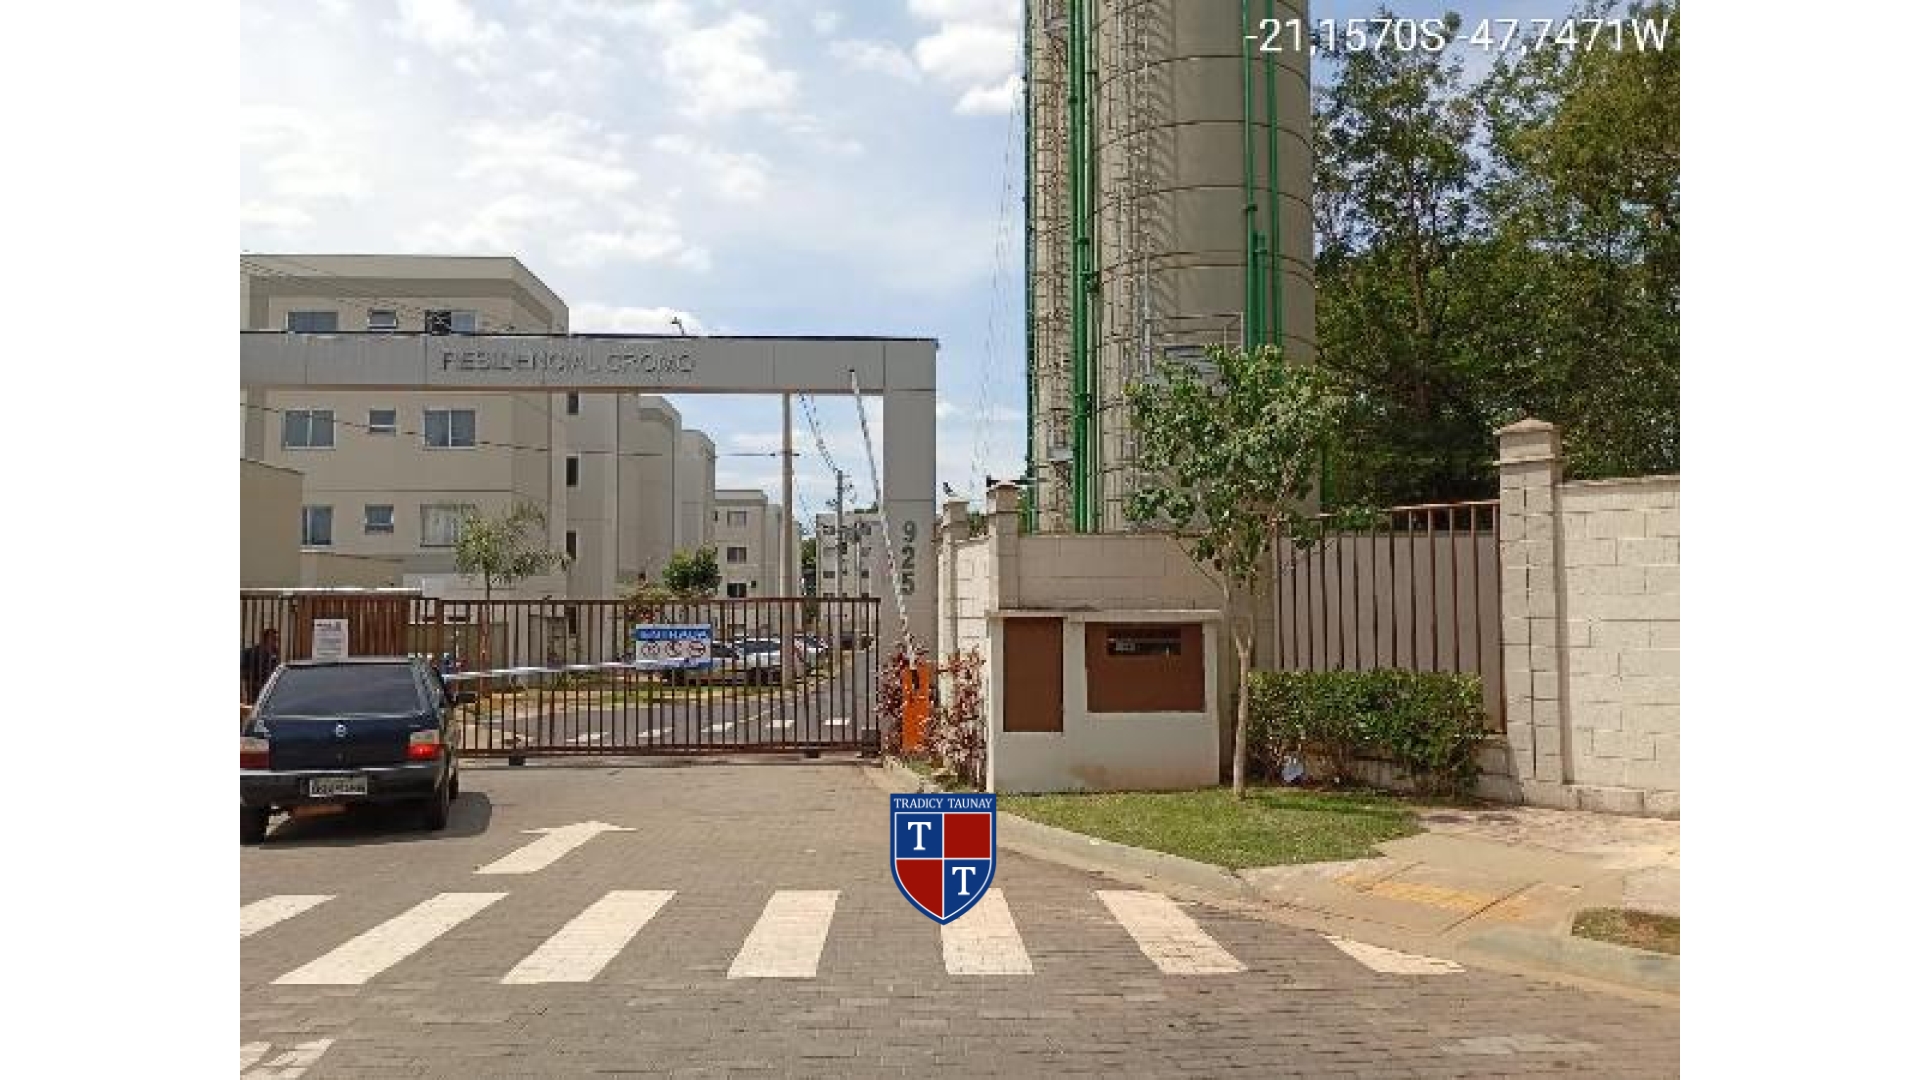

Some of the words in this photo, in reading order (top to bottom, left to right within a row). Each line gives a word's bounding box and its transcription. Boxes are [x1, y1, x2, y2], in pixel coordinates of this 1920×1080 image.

[441, 352, 600, 372] RESIDENCIAL
[606, 353, 696, 374] CROMO
[902, 521, 916, 596] 925
